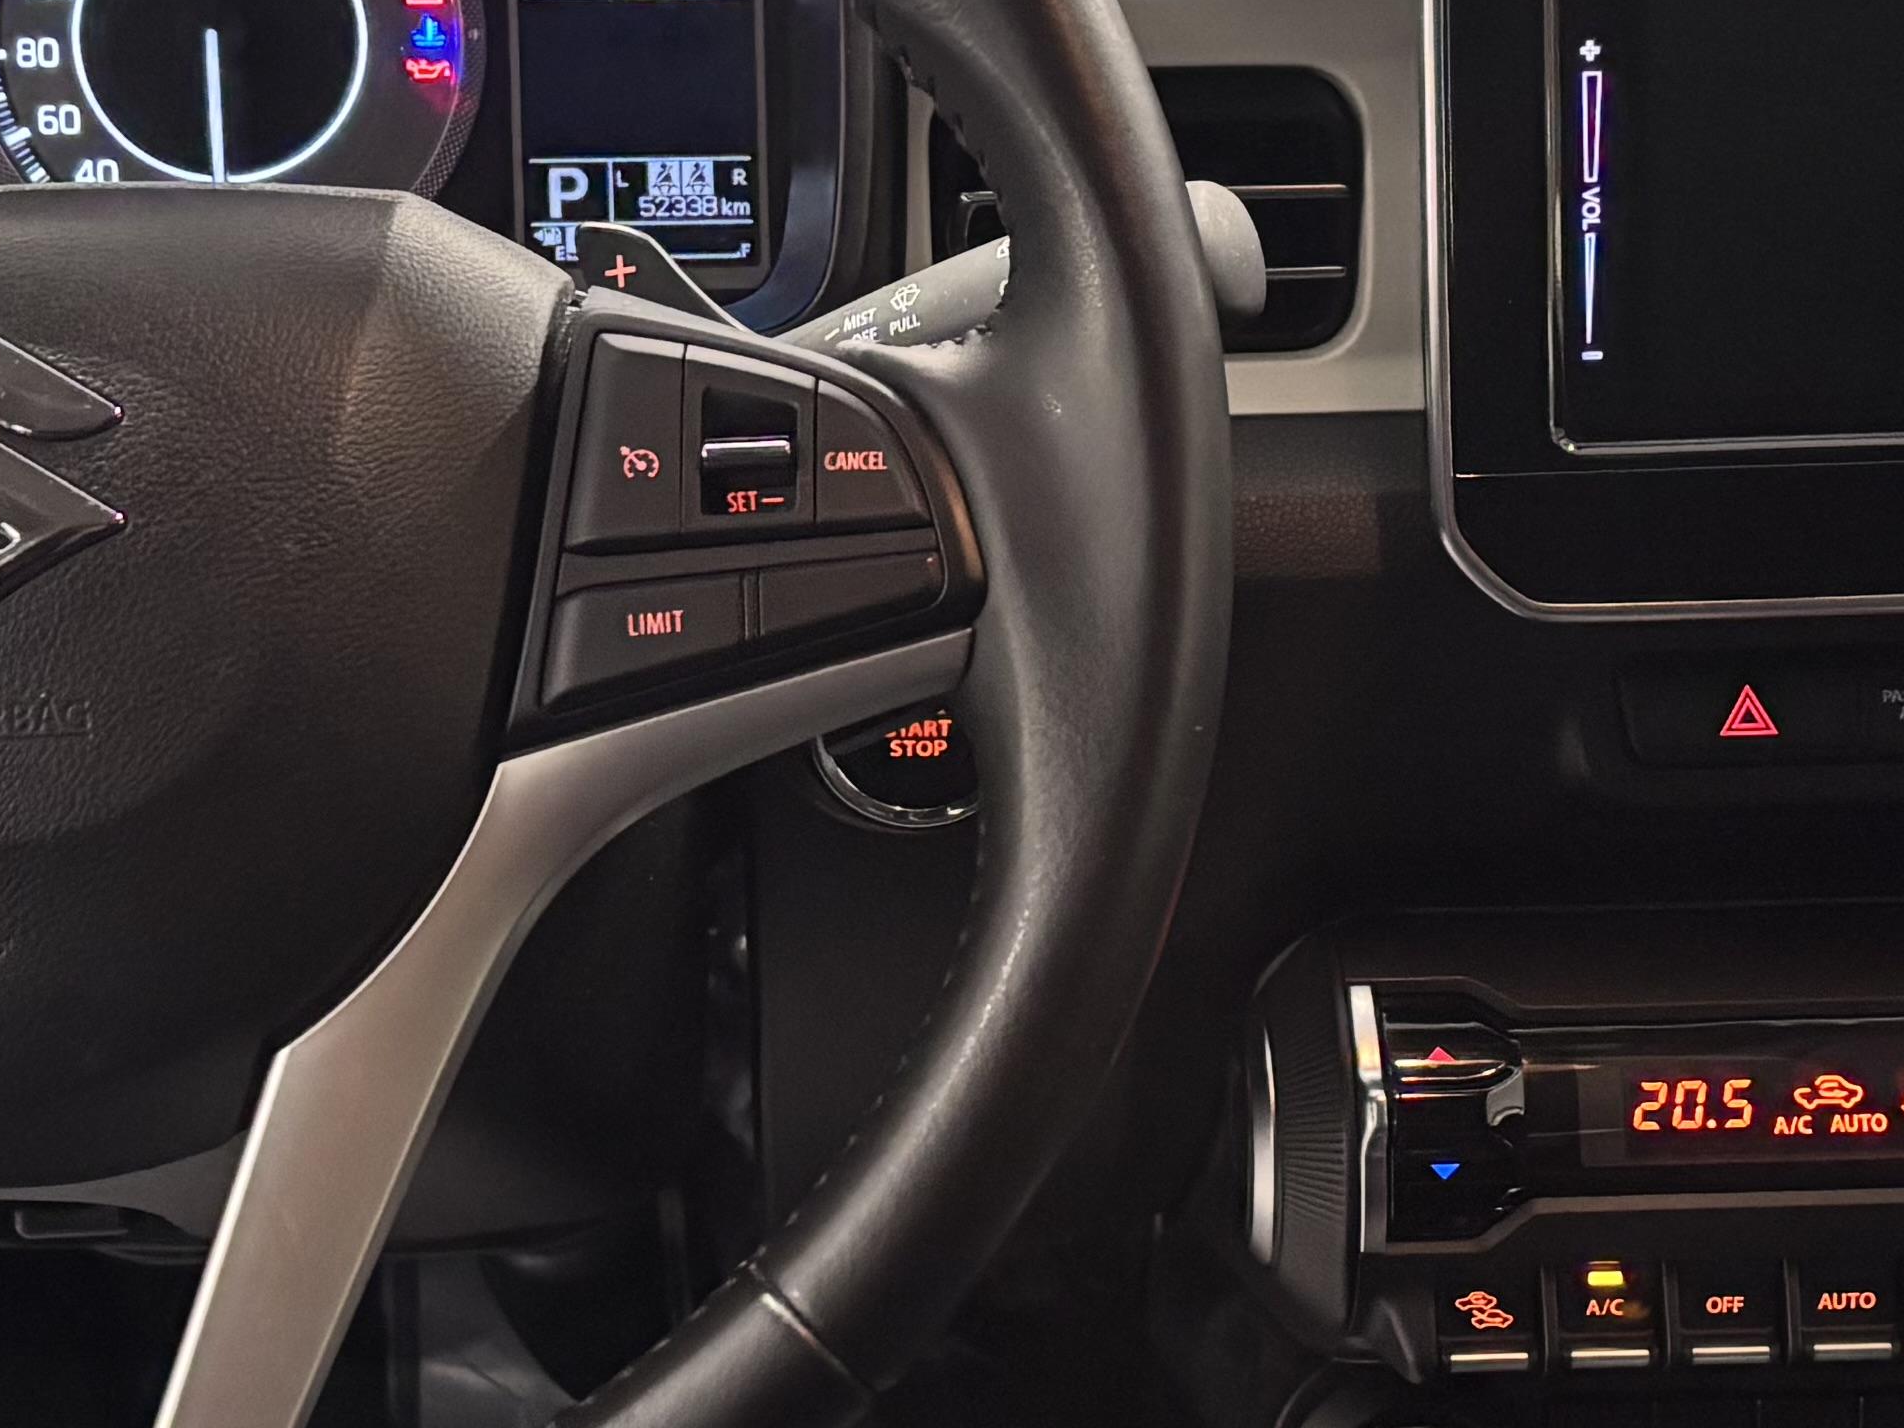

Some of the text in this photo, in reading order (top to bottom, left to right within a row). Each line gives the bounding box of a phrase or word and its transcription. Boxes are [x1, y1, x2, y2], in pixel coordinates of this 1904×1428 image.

[15, 36, 60, 69] 80
[36, 103, 82, 136] 60
[75, 159, 121, 184] 40
[615, 170, 630, 188] L
[731, 167, 748, 186] R
[548, 167, 589, 219] P
[638, 195, 751, 218] 52338 km
[1581, 185, 1600, 232] VOL
[842, 307, 878, 333] MIST
[889, 313, 921, 337] PULL
[824, 450, 888, 471] CANCEL
[726, 490, 758, 513] SET
[627, 609, 684, 637] LIMIT
[885, 719, 953, 738] ART
[889, 739, 948, 758] STOP
[1632, 1078, 1753, 1131] 20.5
[1773, 1112, 1889, 1135] A/C AUTO
[1586, 1298, 1625, 1316] A/C
[1705, 1296, 1745, 1314] OFF
[1817, 1291, 1877, 1310] AUTO
